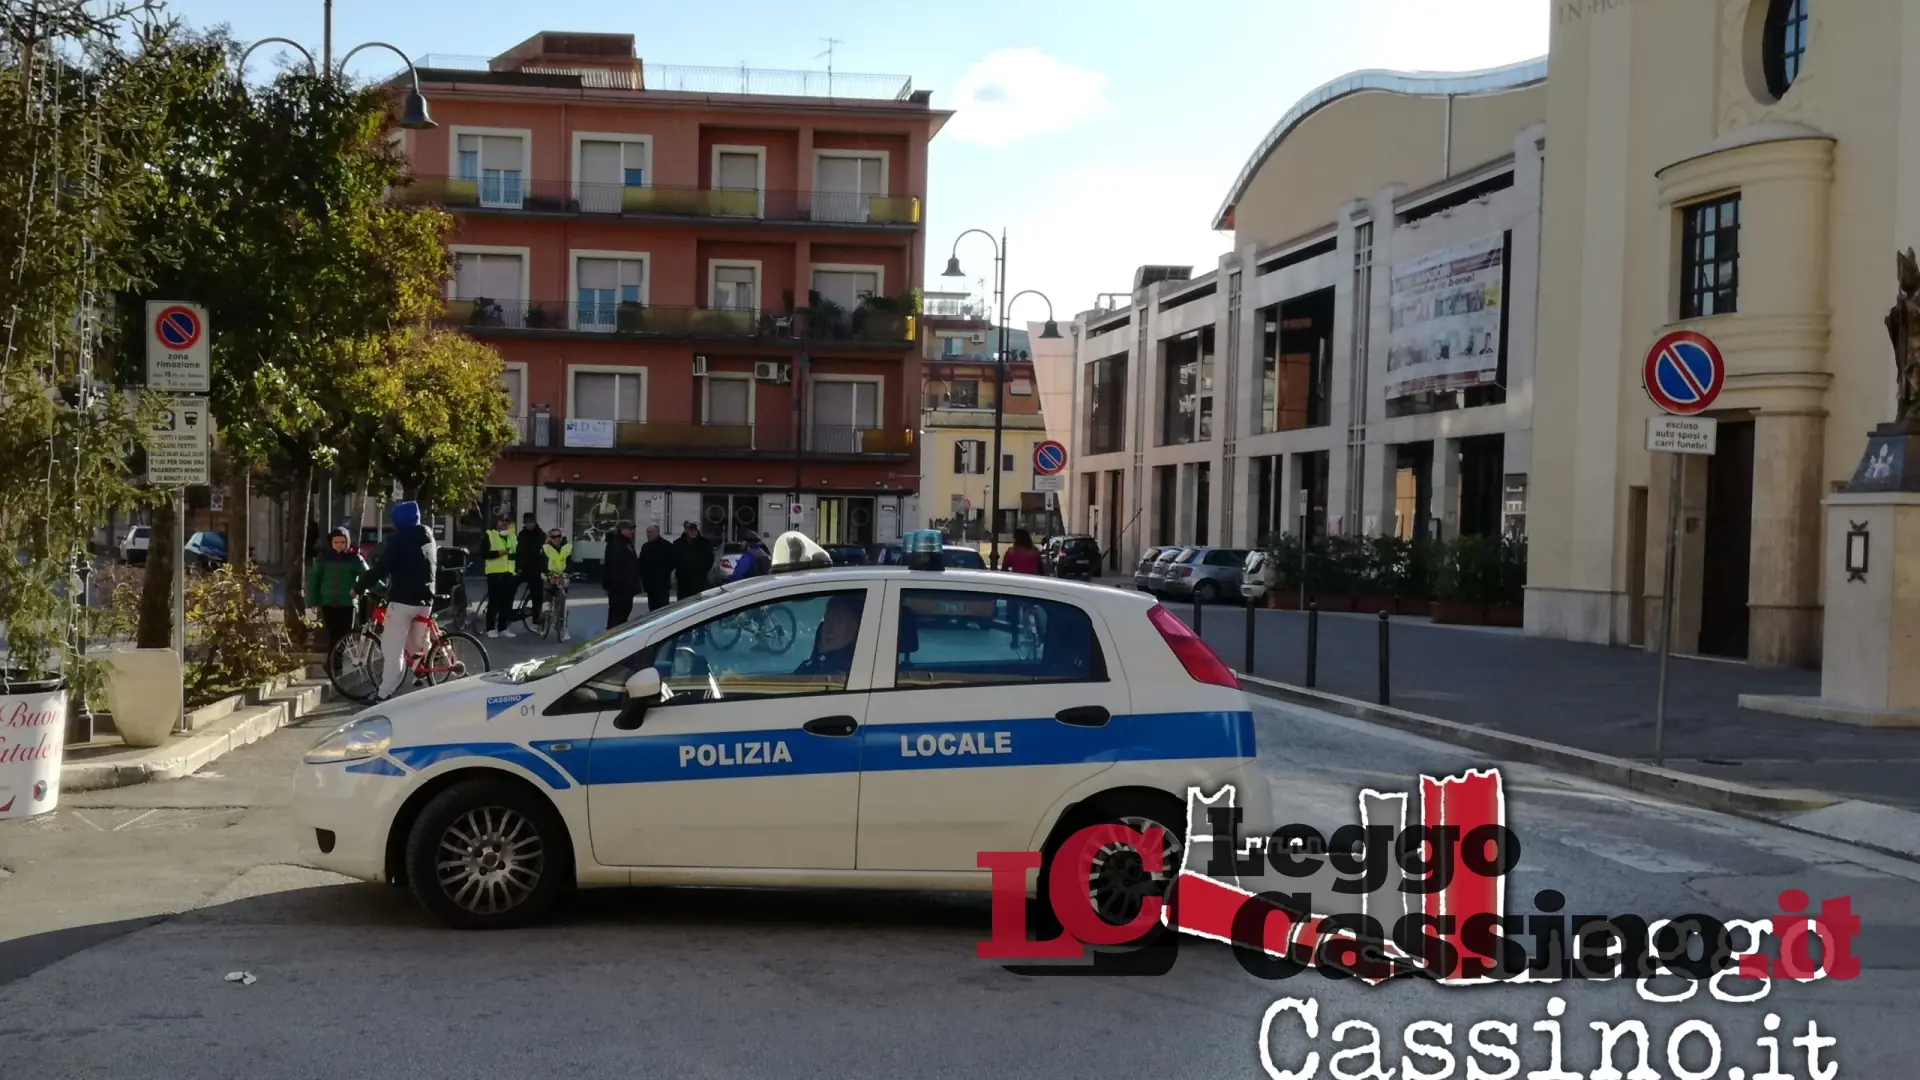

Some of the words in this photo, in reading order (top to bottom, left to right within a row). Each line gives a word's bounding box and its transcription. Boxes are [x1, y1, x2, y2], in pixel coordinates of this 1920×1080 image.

[167, 353, 189, 361] zona
[1665, 421, 1699, 430] escluso
[1655, 430, 1675, 438] auto
[1677, 431, 1700, 440] sposi
[1655, 439, 1675, 448] carri
[1676, 440, 1708, 450] funebri
[487, 695, 522, 705] CASSINO
[520, 704, 536, 717] 01
[0, 733, 52, 764] atale
[679, 740, 793, 768] POLIZIA
[900, 731, 1013, 758] LOCALE
